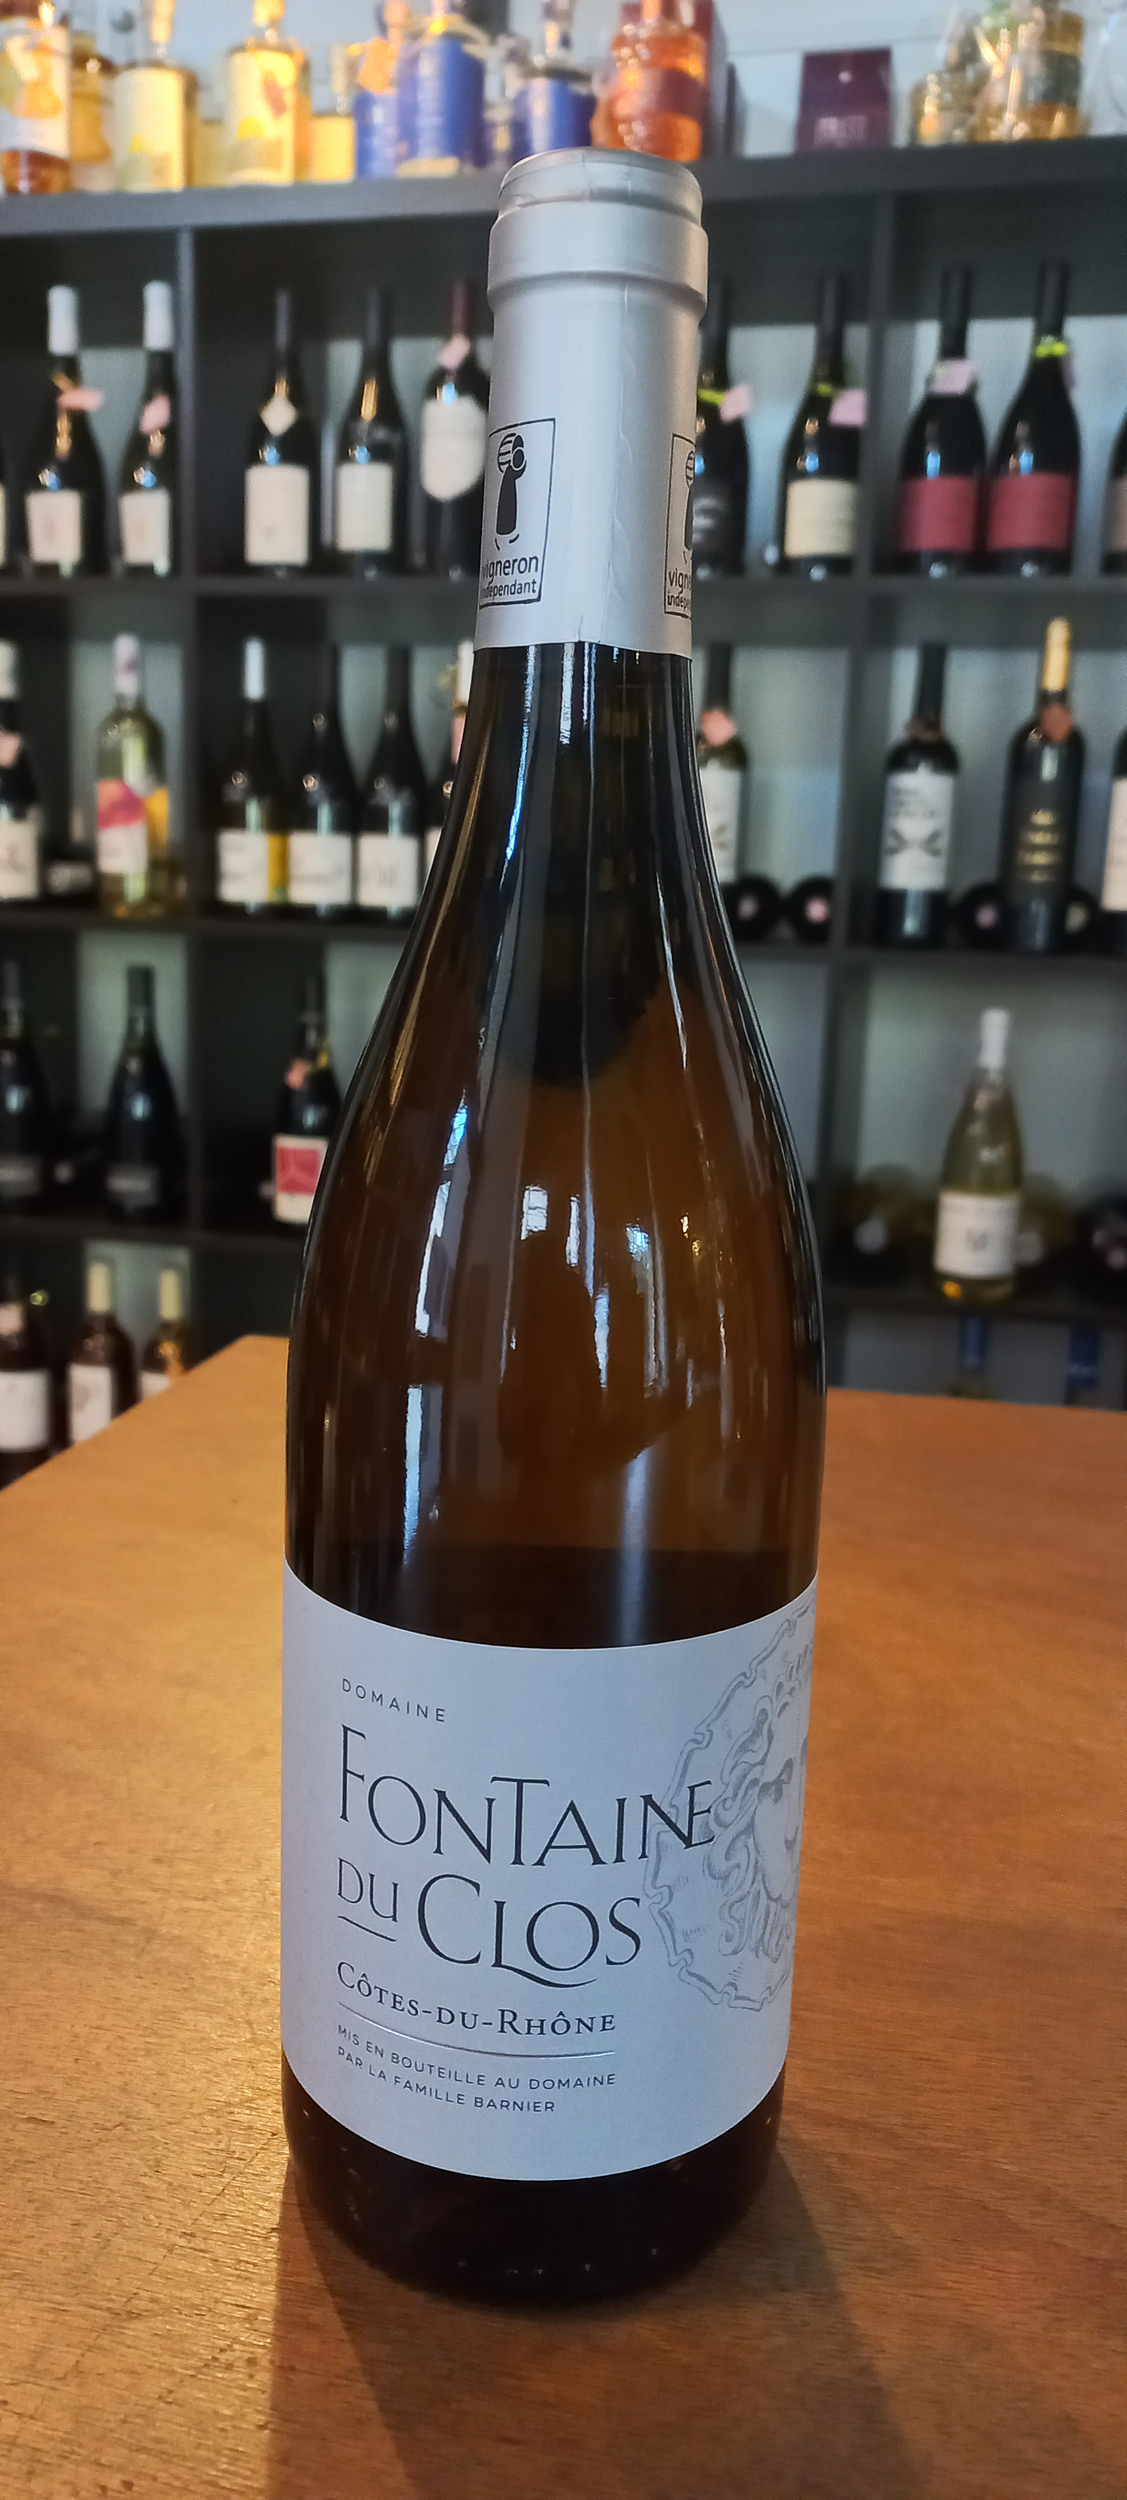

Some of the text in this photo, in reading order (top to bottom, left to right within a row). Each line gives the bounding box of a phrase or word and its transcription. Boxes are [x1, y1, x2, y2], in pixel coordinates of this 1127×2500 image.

[342, 1678, 446, 1722] DOMAINE
[339, 1723, 716, 1866] FONTAINE
[337, 1857, 641, 1989] DU CLOS
[337, 1961, 616, 2036] CÔTES-DU-RHÔNE
[337, 2046, 555, 2113] PAR LA FAMILLE BARNIER
[338, 2025, 616, 2090] MIS EN BOUTEILLE AU DOMAINE
